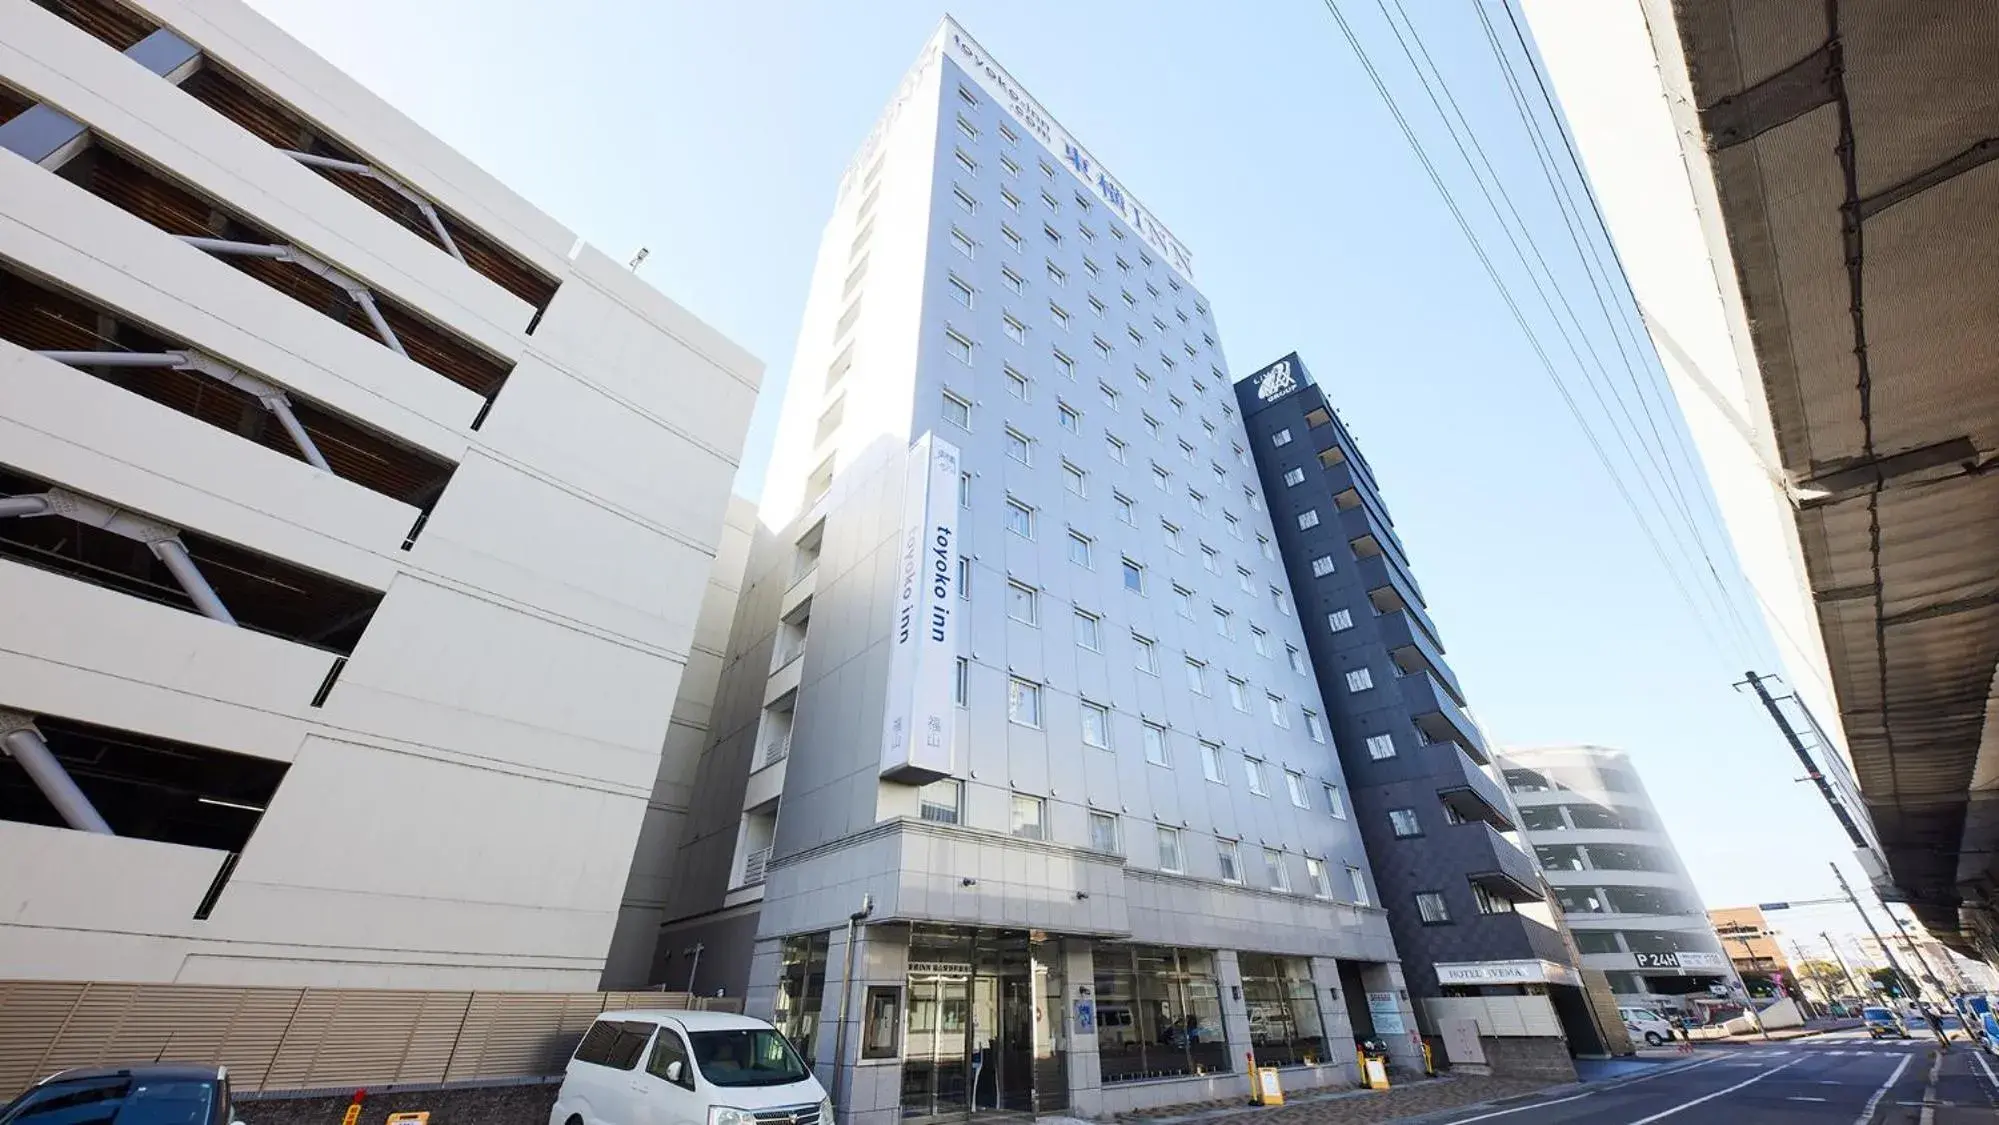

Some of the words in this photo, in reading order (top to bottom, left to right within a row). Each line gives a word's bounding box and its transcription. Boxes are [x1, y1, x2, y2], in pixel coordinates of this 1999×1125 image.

[933, 525, 952, 599] toyoko
[899, 604, 913, 644] inn
[932, 605, 950, 642] inn
[1448, 969, 1482, 979] HOTEL
[1637, 954, 1648, 968] P
[1650, 953, 1678, 967] 24H
